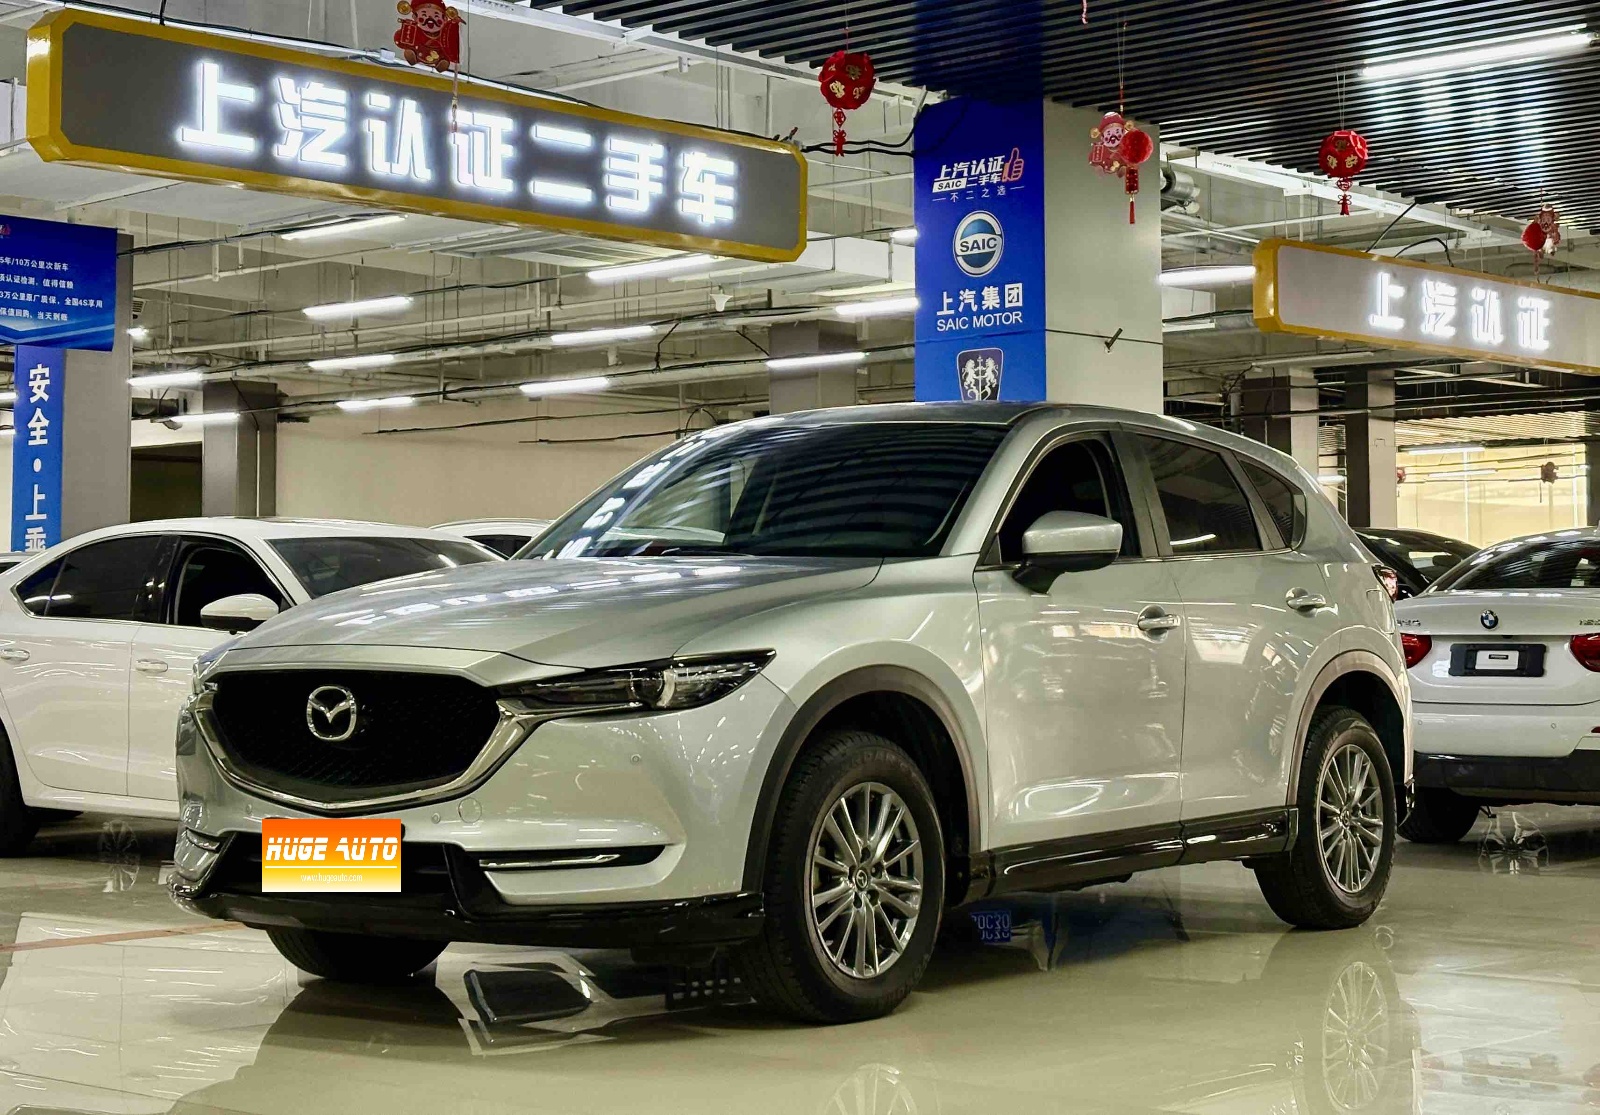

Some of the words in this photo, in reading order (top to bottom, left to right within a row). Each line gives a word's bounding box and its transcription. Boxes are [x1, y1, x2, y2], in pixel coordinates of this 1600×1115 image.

[177, 60, 738, 224] 上汽认证二手车
[934, 155, 1006, 181] 上汽认证
[937, 180, 962, 191] SAIC
[966, 173, 1002, 187] 二手车
[950, 185, 1006, 203] 不二之选
[960, 237, 998, 253] SAIC
[936, 283, 1023, 316] 上汽集团
[936, 316, 969, 332] SAIC
[972, 311, 1023, 328] MOTOR
[1368, 271, 1551, 351] 上汽认证
